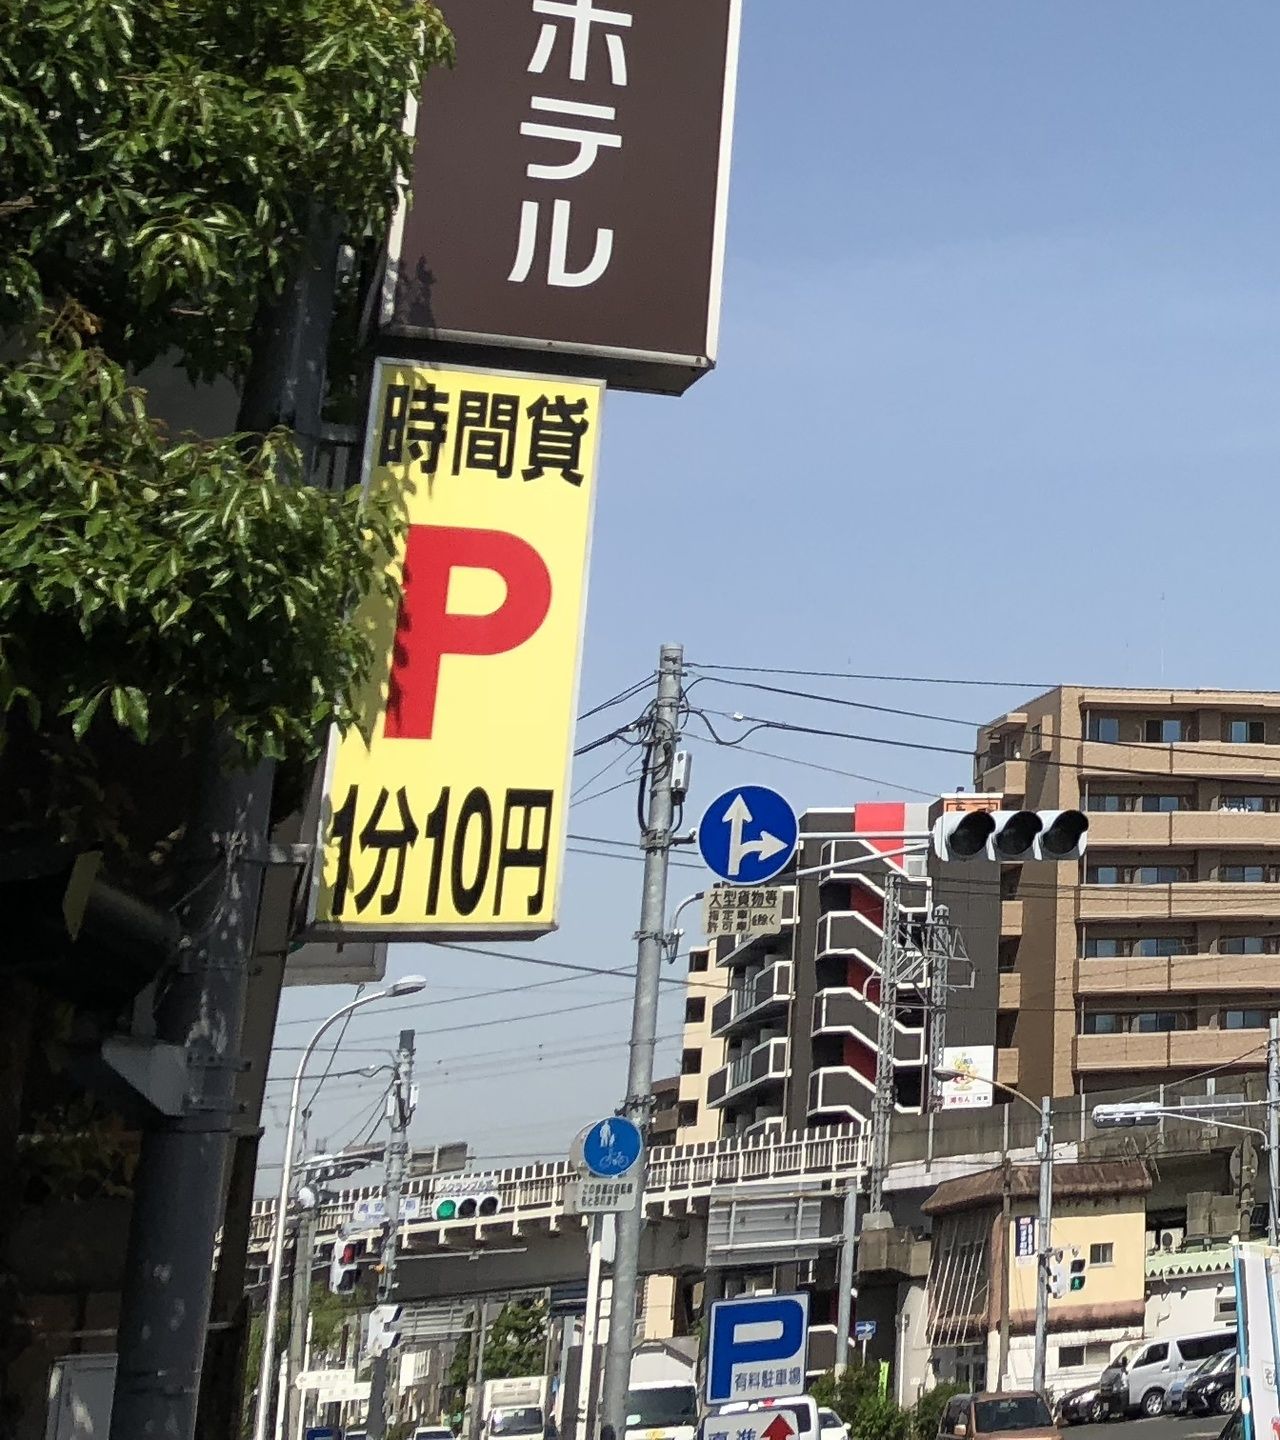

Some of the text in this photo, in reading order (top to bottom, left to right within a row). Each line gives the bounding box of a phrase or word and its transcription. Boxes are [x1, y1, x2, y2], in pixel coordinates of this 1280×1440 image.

[380, 383, 590, 487] 時間貸
[383, 523, 553, 740] P
[710, 1299, 804, 1399] P
[735, 1366, 800, 1392] 有料駐車場
